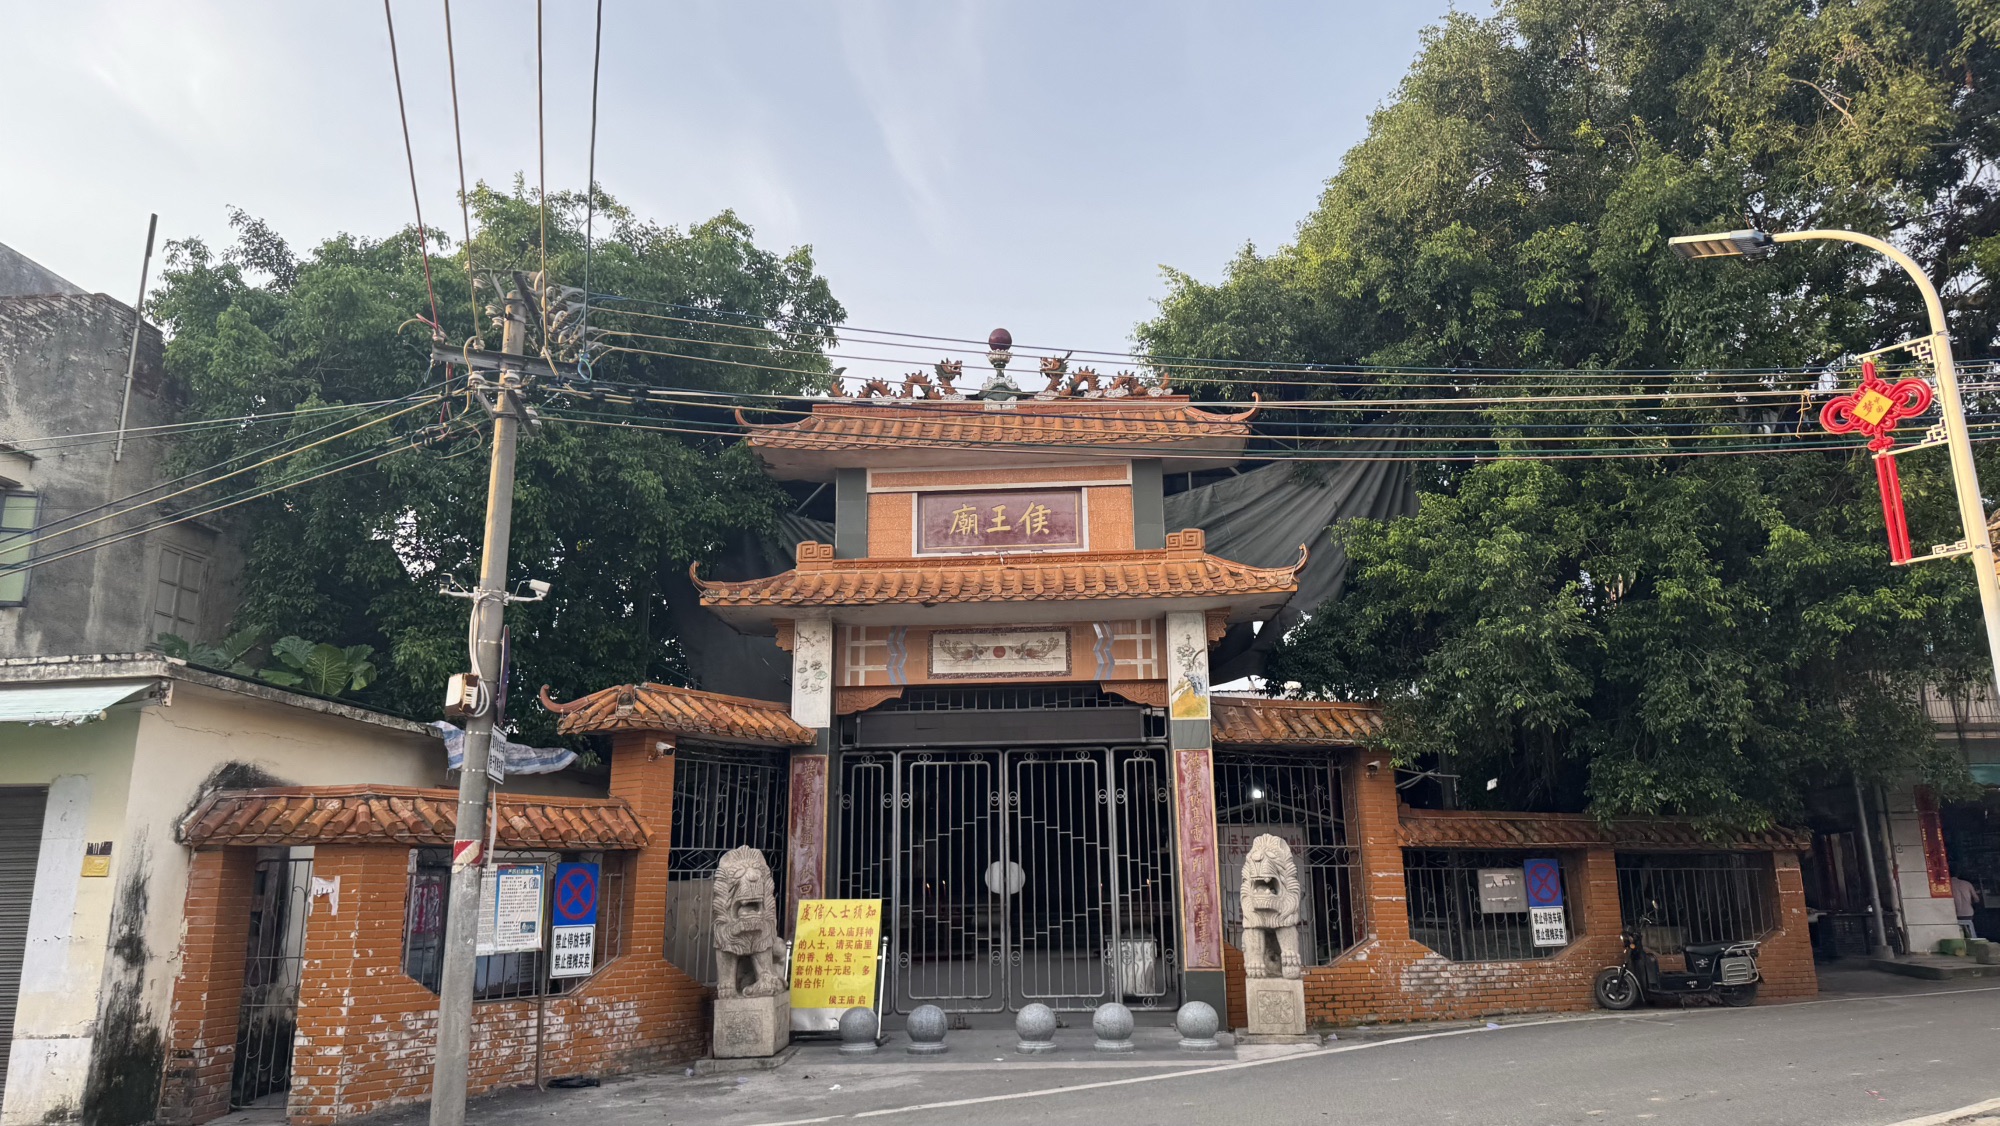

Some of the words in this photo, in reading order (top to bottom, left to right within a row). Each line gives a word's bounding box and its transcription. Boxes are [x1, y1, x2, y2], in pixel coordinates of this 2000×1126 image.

[801, 904, 876, 921] 虔信人士须知
[1534, 912, 1562, 925] 禁止停放车辆
[818, 926, 874, 938] 凡是入庙拜神
[555, 932, 591, 949] 禁止停放车辆
